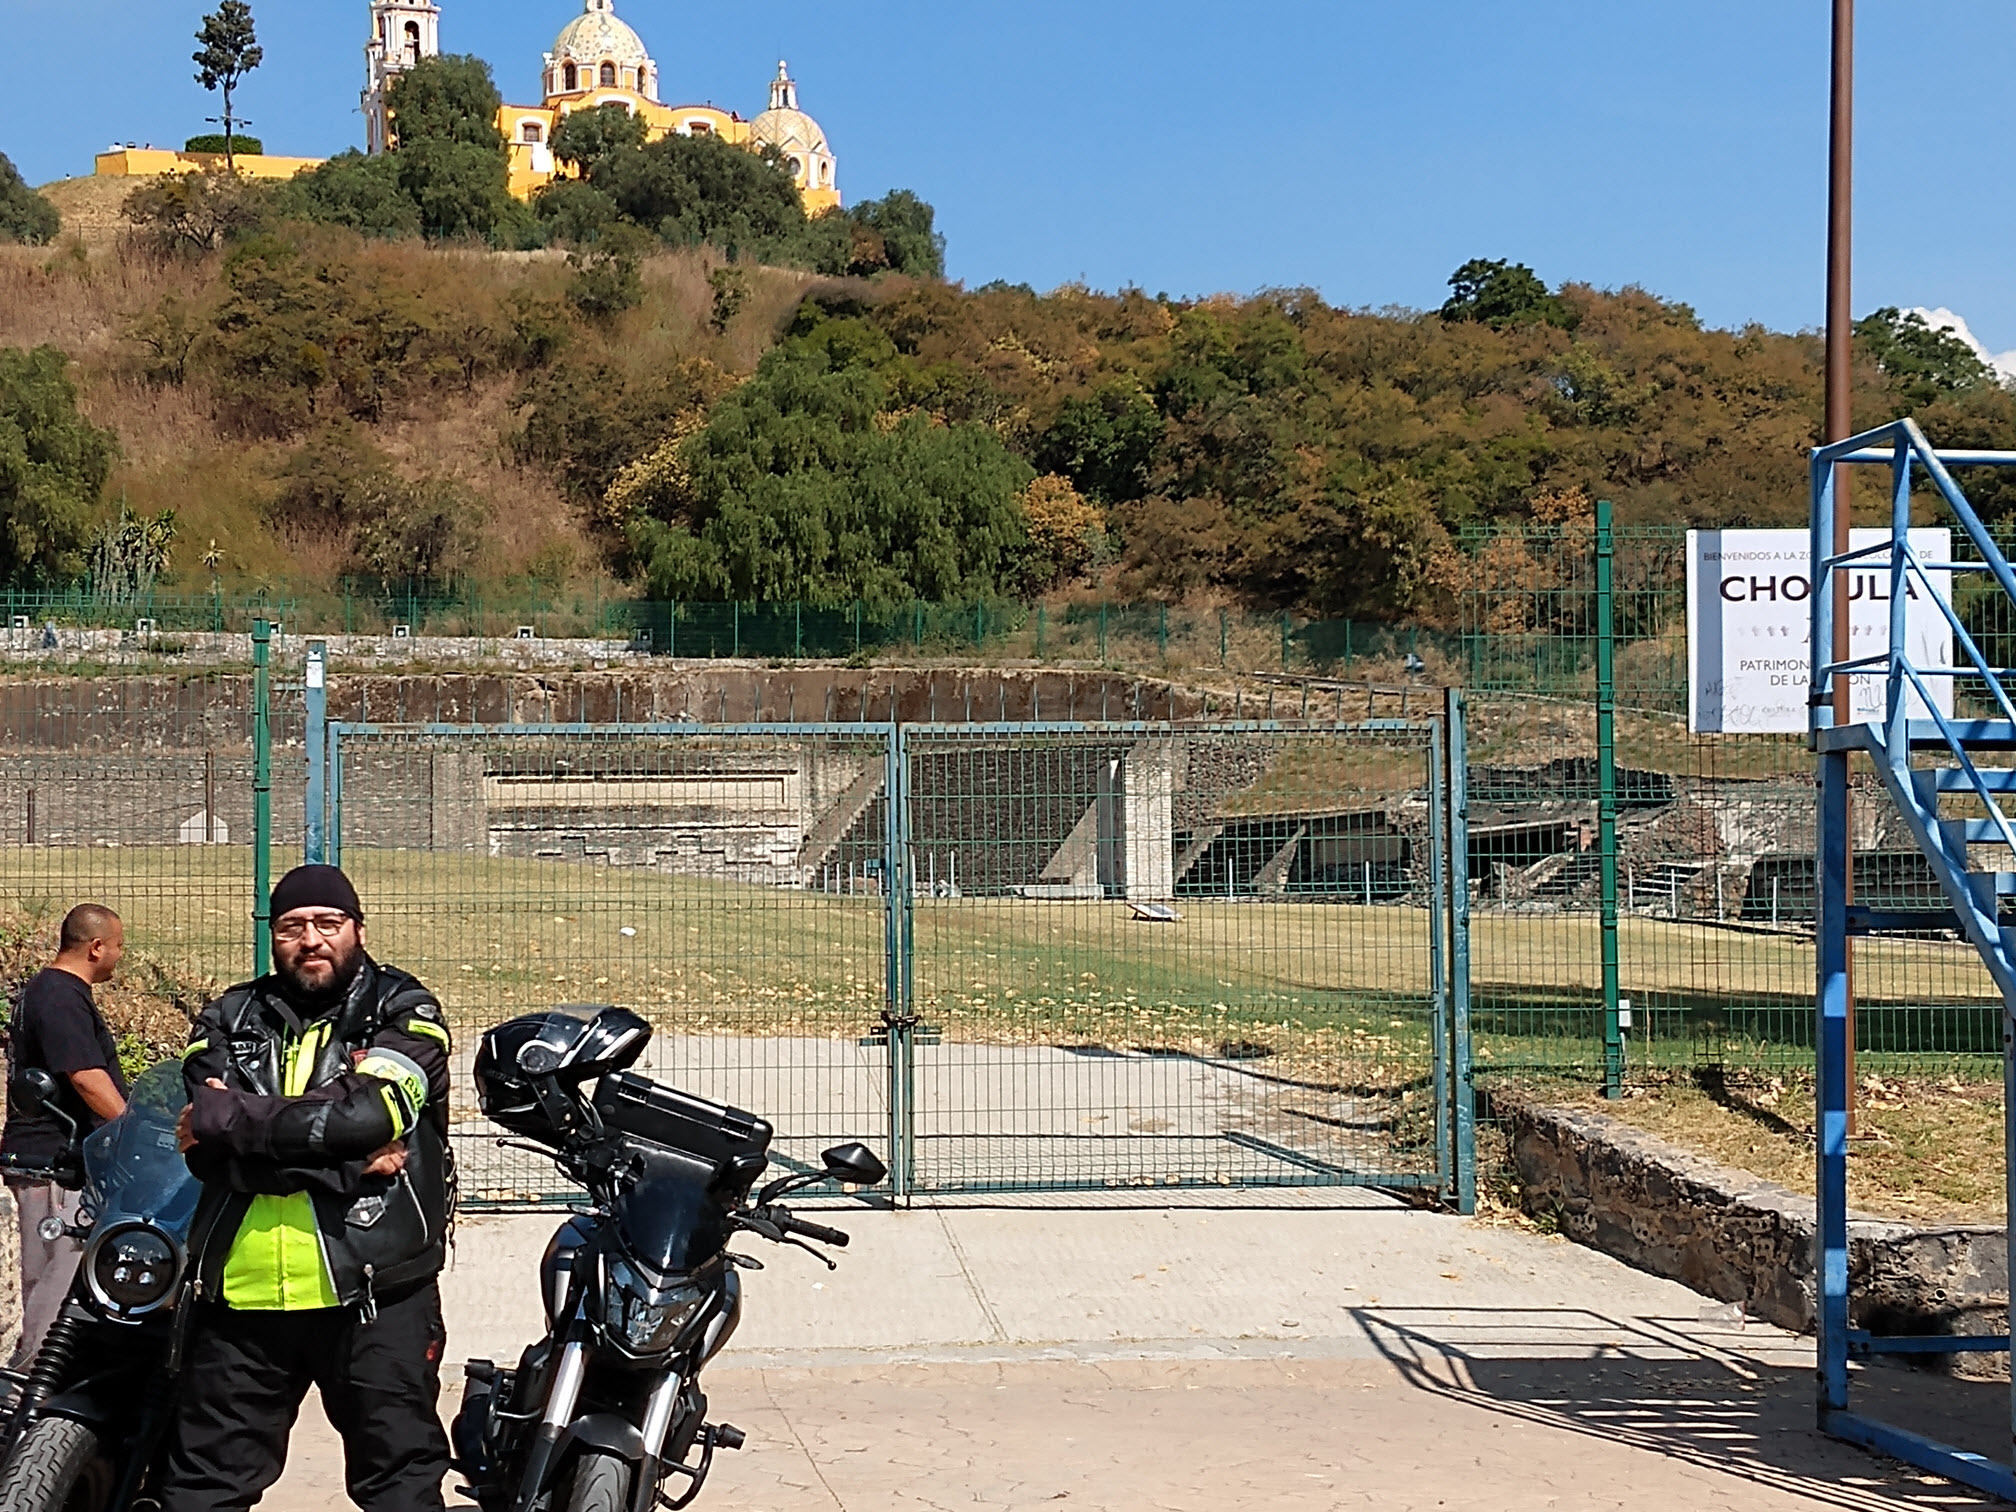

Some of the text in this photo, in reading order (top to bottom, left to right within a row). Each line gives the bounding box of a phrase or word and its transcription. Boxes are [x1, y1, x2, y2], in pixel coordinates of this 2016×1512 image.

[1703, 551, 1772, 561] BIENVENIDOS
[1773, 551, 1781, 560] A
[1784, 551, 1796, 560] LA
[1919, 550, 1934, 559] DE
[1719, 575, 1919, 601] CHOULA
[1740, 660, 1811, 671] PATRIMON
[1770, 675, 1809, 686] DE LA
